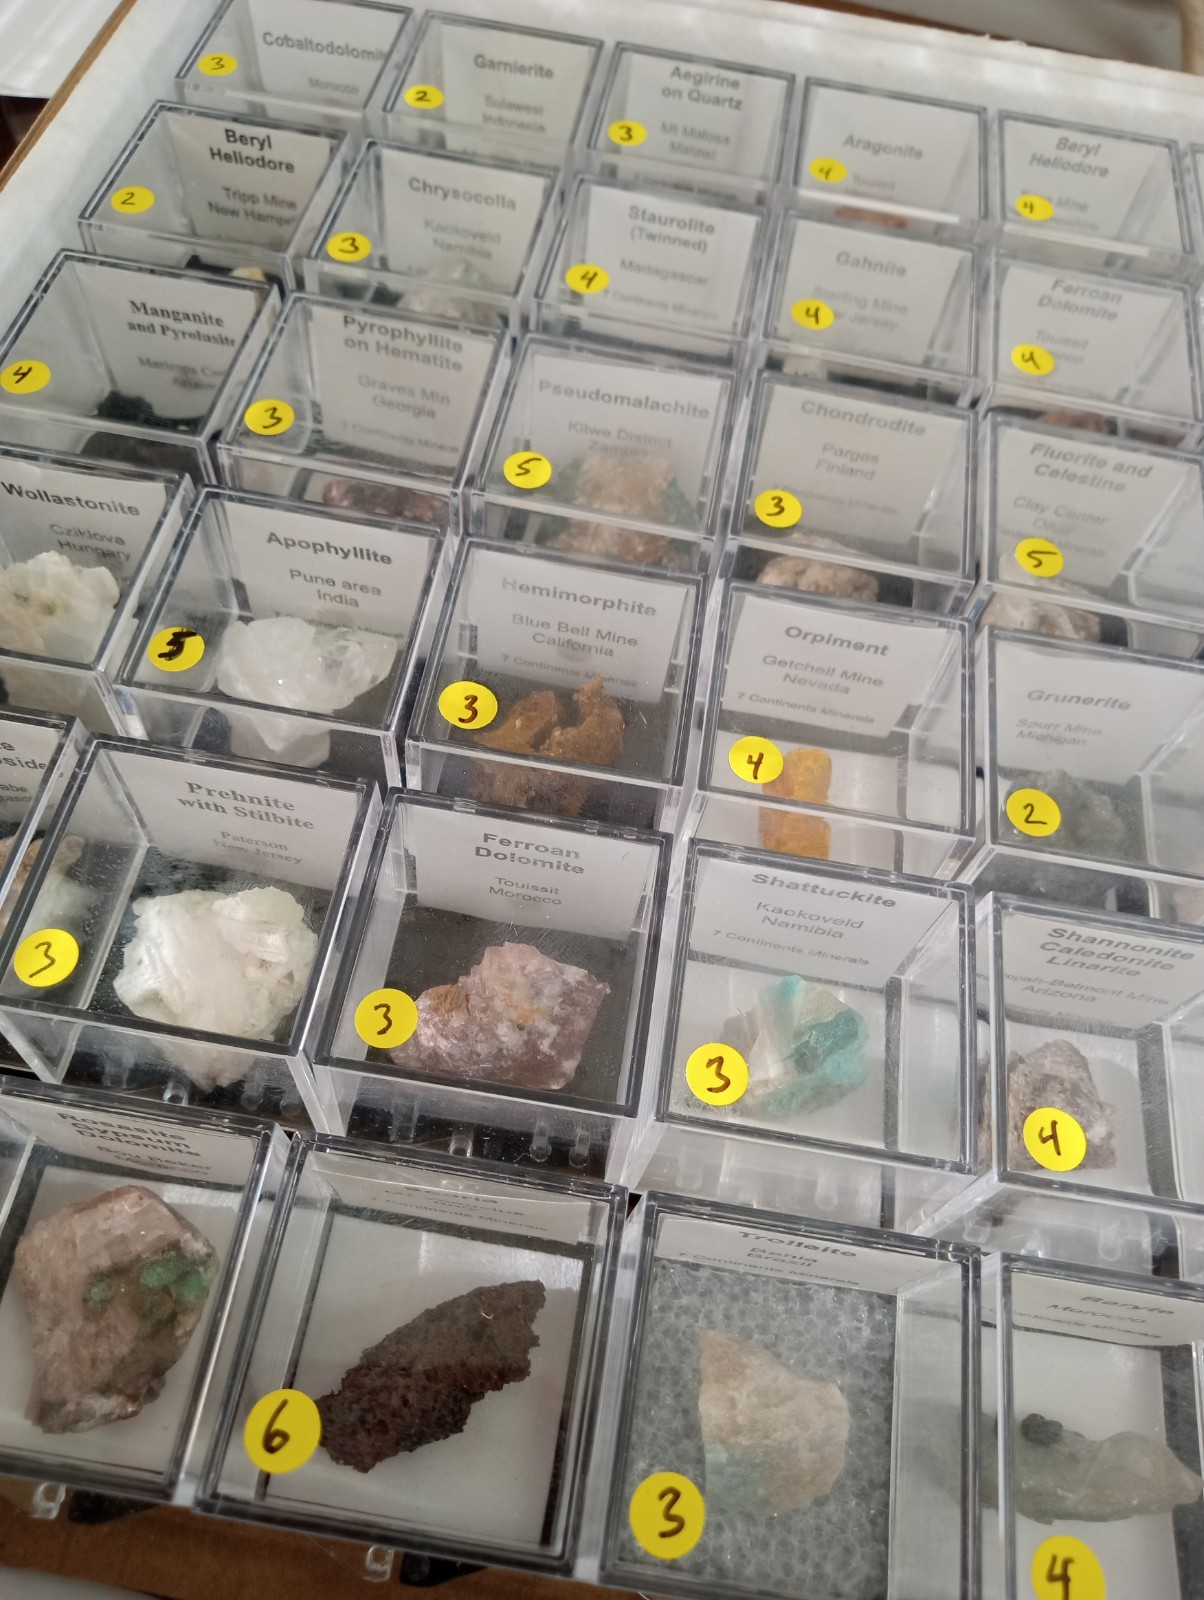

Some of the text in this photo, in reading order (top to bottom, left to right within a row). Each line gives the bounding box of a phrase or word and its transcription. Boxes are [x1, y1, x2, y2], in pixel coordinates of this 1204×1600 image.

[210, 56, 225, 70] 3
[473, 53, 554, 80] Garnierite
[670, 66, 740, 90] Aegirine
[415, 90, 431, 102] 2
[661, 86, 744, 111] on Quartz
[224, 128, 272, 151] Beryl
[618, 125, 634, 142] 3
[843, 134, 924, 160] Aragonite
[209, 147, 295, 173] Heliodore
[1055, 137, 1103, 158] Beryl
[818, 166, 833, 181] 4
[1029, 152, 1109, 179] Heliodore
[121, 192, 136, 206] 2
[222, 187, 297, 211] Tripp Mine
[408, 176, 516, 211] Chrysocolla
[208, 201, 240, 219] New
[628, 205, 715, 235] Staurolite
[1022, 201, 1034, 214] 4
[338, 237, 359, 254] 3
[433, 238, 493, 260] Namibia
[631, 226, 708, 254] (Twinned)
[619, 258, 710, 287] Madagascar
[835, 251, 907, 278] Gahnite
[580, 271, 599, 289] 4
[1051, 278, 1122, 305] Ferroan
[129, 300, 225, 328] Manganite
[805, 306, 820, 325] 4
[1037, 294, 1118, 322] Dolomite
[127, 319, 236, 347] and Pyrolusite
[343, 315, 463, 353] Pyrophyllite
[344, 337, 463, 373] on Hematite
[1021, 351, 1041, 371] 4
[13, 366, 33, 384] 4
[357, 375, 417, 398] Graves
[372, 395, 436, 419] Georgia
[538, 379, 710, 420] Pseudomalachite
[262, 406, 283, 429] 3
[801, 400, 926, 437] Chondrodite
[616, 428, 673, 449] District
[515, 458, 542, 476] 5
[821, 442, 880, 465] Pargas
[1030, 443, 1154, 478] Fluorite and
[815, 459, 876, 481] Finland
[1034, 463, 1127, 493] Celestine
[1, 481, 140, 516] Wollastonite
[766, 496, 785, 517] 3
[1013, 495, 1108, 526] Clay Center
[50, 524, 126, 546] Cziklova
[267, 531, 393, 565] Apophyllite
[58, 539, 131, 561] Hungary
[1026, 550, 1058, 569] 5
[289, 568, 382, 597] Pune area
[317, 589, 359, 609] India
[502, 576, 657, 617] Hemimorphite
[512, 613, 638, 647] Blue Bell Mine
[784, 625, 890, 657] Orpiment
[532, 632, 615, 658] California
[513, 657, 581, 677] Continents
[762, 655, 884, 687] Getchell Mine
[782, 673, 851, 695] Nevada
[458, 694, 479, 723] 3
[749, 694, 817, 714] Continents
[820, 707, 875, 724] Minerals
[1027, 689, 1132, 711] Grunerite
[1015, 718, 1104, 736] Spurr Mine
[1015, 730, 1088, 747] Michigan
[747, 752, 764, 780] 4
[186, 781, 295, 811] Prehnite
[177, 798, 315, 830] with Stilbite
[1023, 803, 1048, 825] 2
[220, 831, 288, 851] Paterson
[483, 832, 580, 860] Ferroan
[255, 849, 302, 865] Jersey
[475, 846, 585, 874] Dolomite
[489, 886, 562, 905] Morocco
[495, 876, 559, 895] Touissit
[752, 873, 896, 908] Shattuckite
[756, 902, 865, 930] Kaokoveld
[761, 915, 844, 939] Namibia
[726, 932, 803, 954] Continents
[809, 951, 871, 966] Minerals
[1039, 942, 1175, 970] Caledonite
[1048, 928, 1194, 961] Shannonite
[29, 942, 56, 979] 3
[1046, 957, 1141, 977] Linarite
[1022, 985, 1097, 1003] Arizona
[1127, 992, 1168, 1005] Mine
[374, 1003, 393, 1035] 3
[706, 1056, 730, 1093] 3
[57, 1112, 186, 1141] Rosasite
[71, 1122, 190, 1149] Gypsum
[1038, 1120, 1061, 1156] 4
[76, 1129, 202, 1157] Dolomite
[738, 1231, 857, 1258] Trolleite
[693, 1254, 784, 1273] Continents
[789, 1270, 860, 1286] Minerals
[1048, 1304, 1147, 1324] Morocco
[262, 1399, 291, 1454] 6
[657, 1486, 686, 1539] 3
[1046, 1553, 1073, 1600] 4
